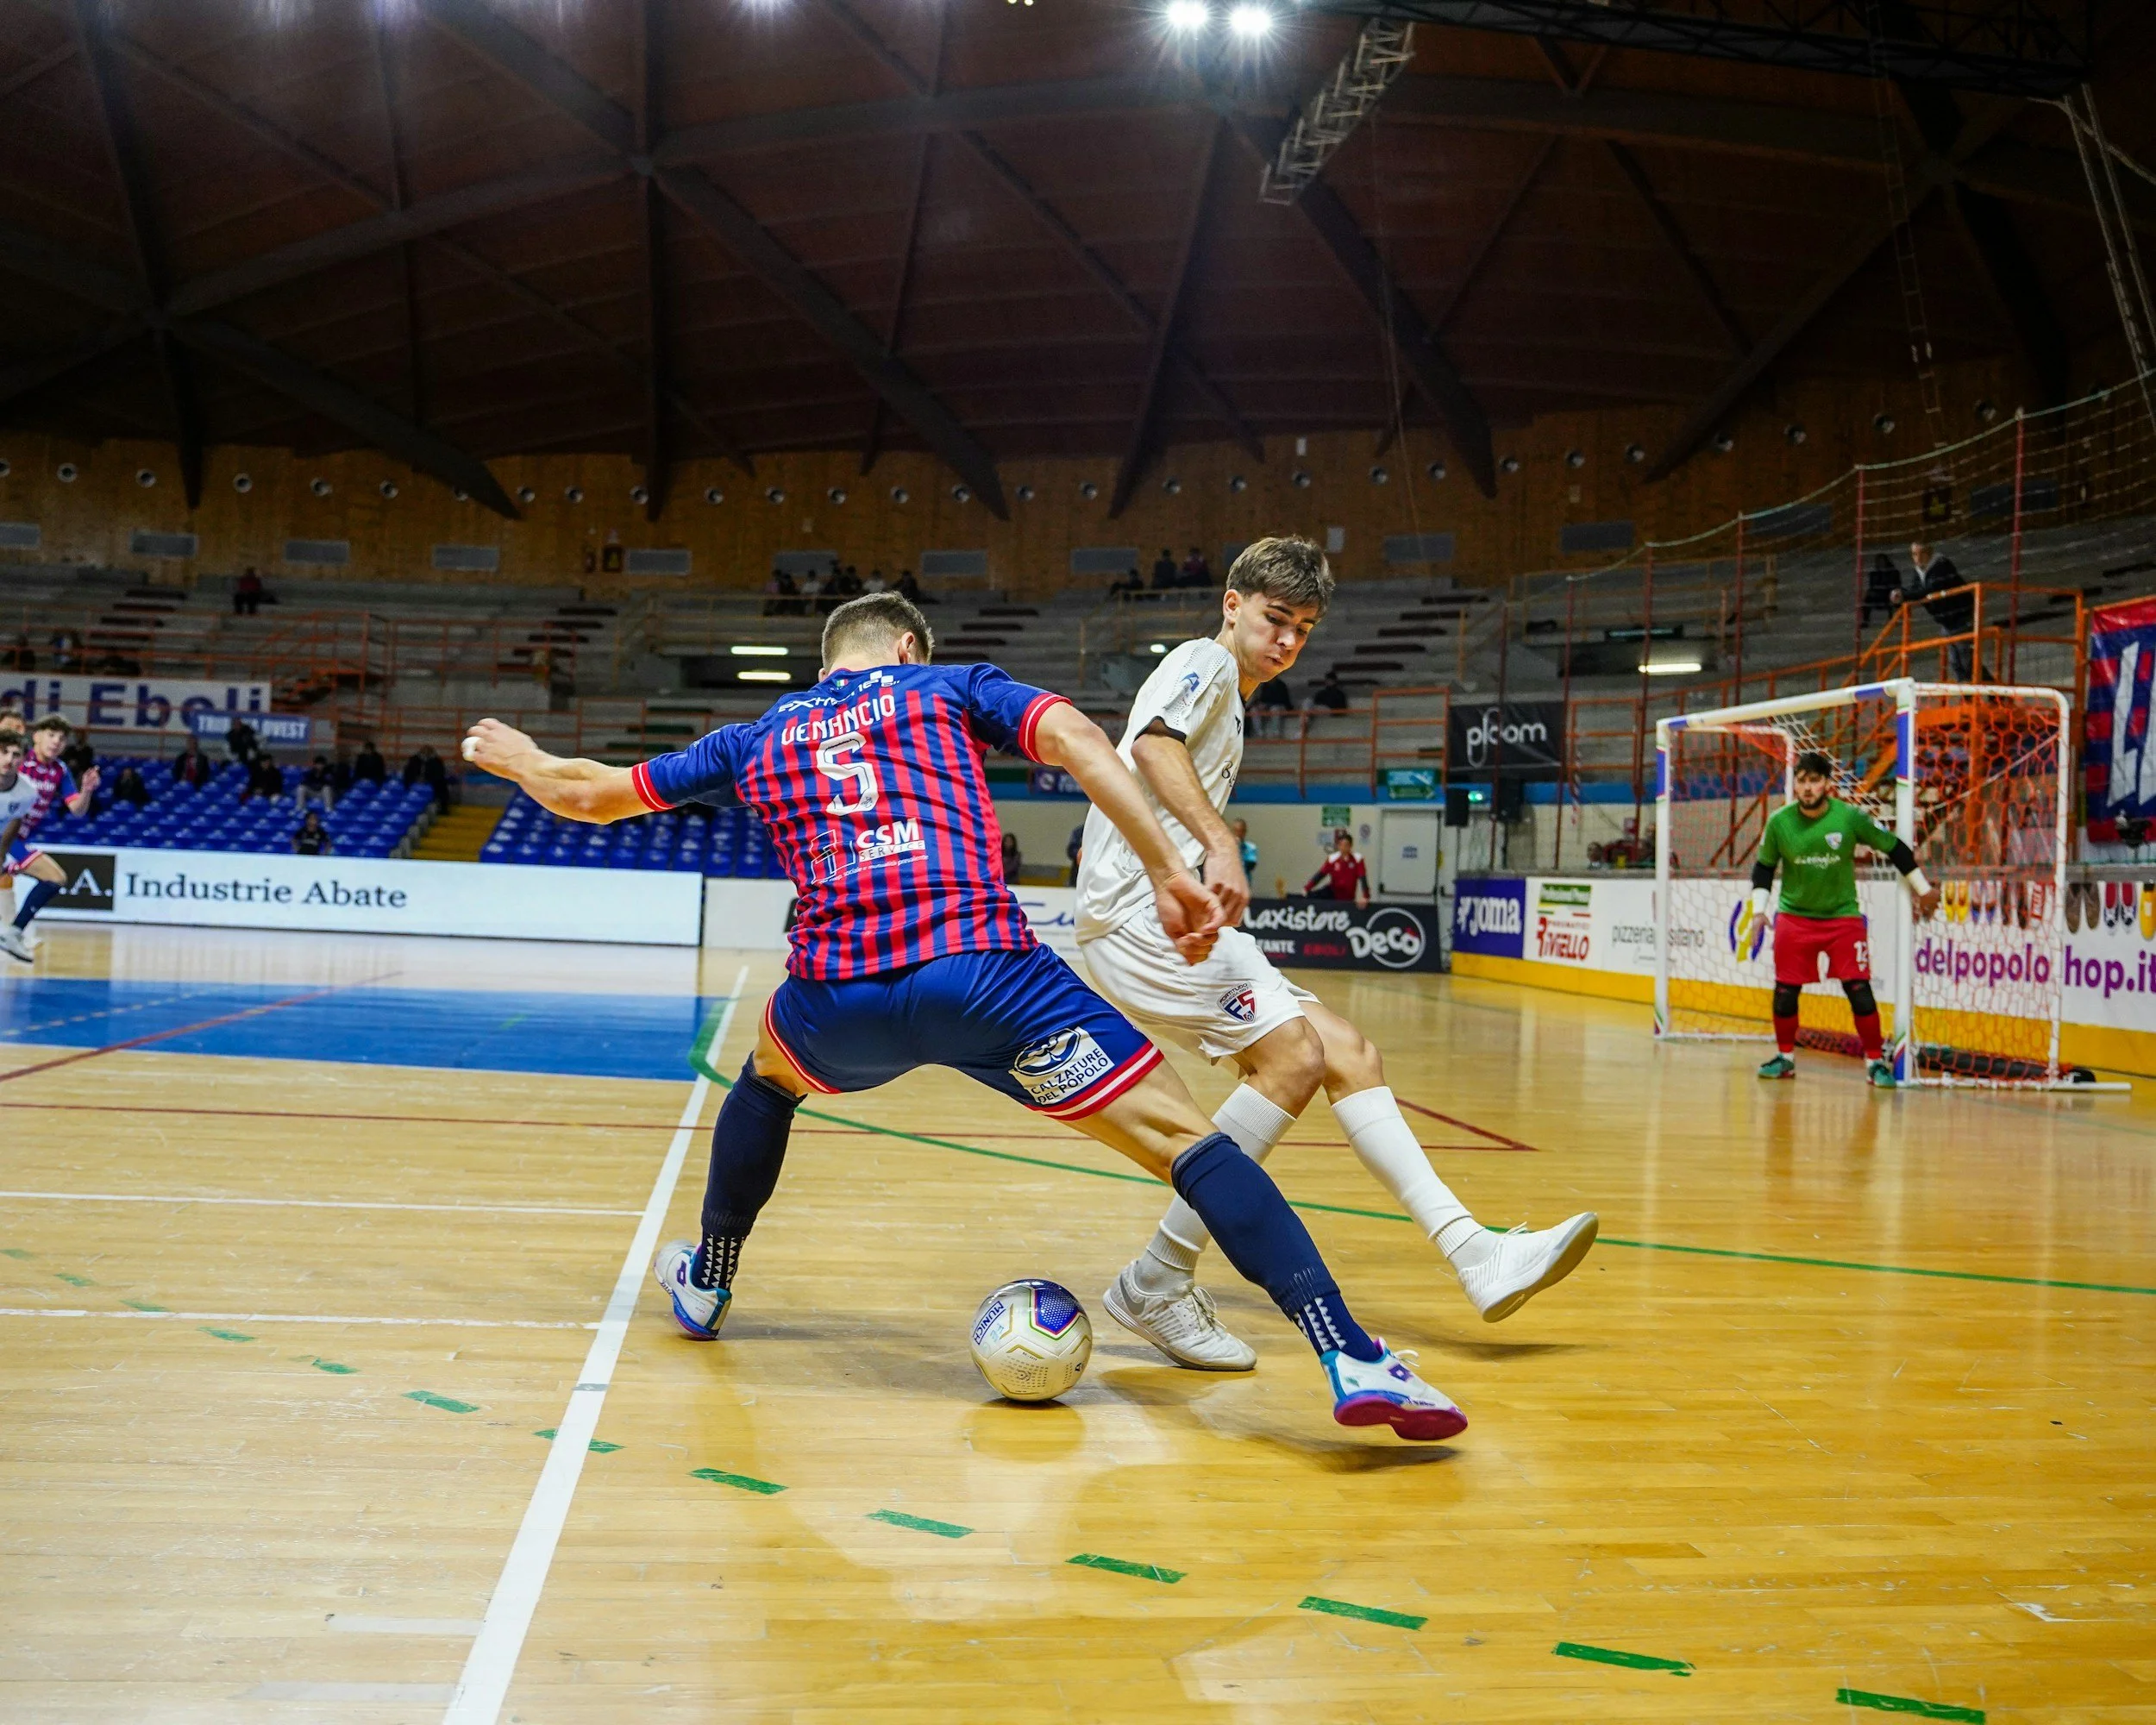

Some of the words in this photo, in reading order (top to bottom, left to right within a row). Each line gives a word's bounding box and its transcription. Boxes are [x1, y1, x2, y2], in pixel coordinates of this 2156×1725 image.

[89, 682, 260, 726] Eboli
[816, 731, 879, 816] 5
[856, 817, 920, 849] CSM
[859, 842, 924, 860] SERVICE
[126, 873, 292, 904] Industrie
[302, 881, 408, 908] Abate
[1031, 1048, 1102, 1095] CALZATURE
[1037, 1089, 1060, 1103] DEL
[1058, 1057, 1108, 1094] POPOLO
[975, 1302, 1005, 1343] MUNICH
